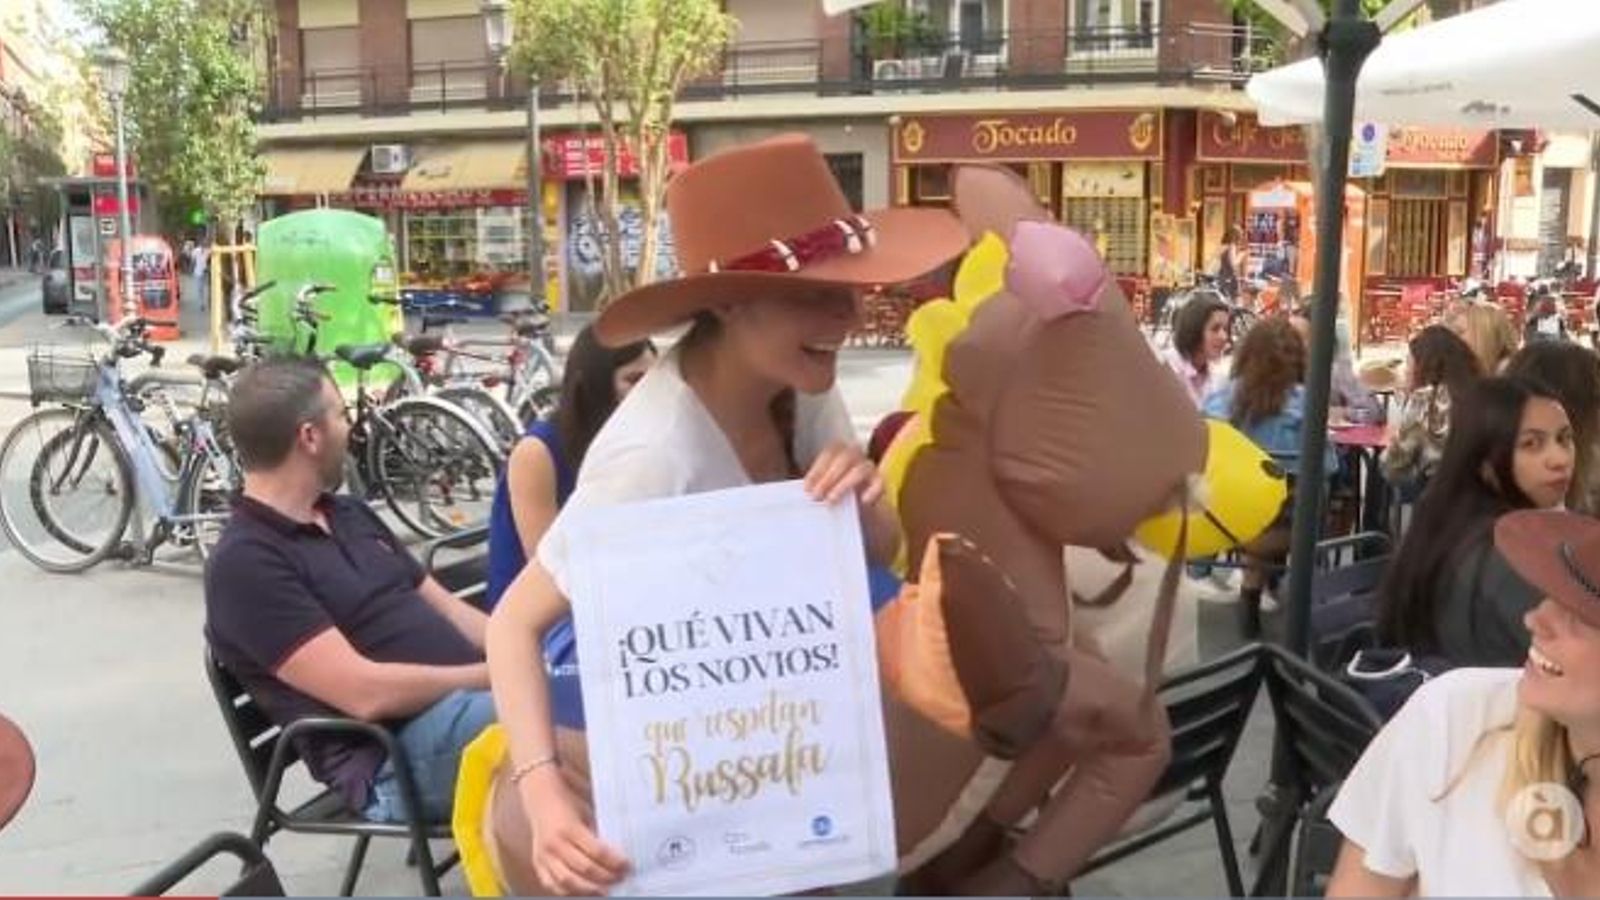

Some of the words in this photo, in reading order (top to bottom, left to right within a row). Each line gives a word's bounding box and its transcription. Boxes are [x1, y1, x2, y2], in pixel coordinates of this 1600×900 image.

[973, 117, 1077, 154] Tocado
[618, 609, 710, 668] ¡QUÉ
[713, 600, 835, 645] VIVAN
[624, 663, 691, 698] LOS
[697, 642, 840, 688] NOVIOS!
[704, 689, 822, 741] respetan
[638, 726, 829, 812] Russafa
